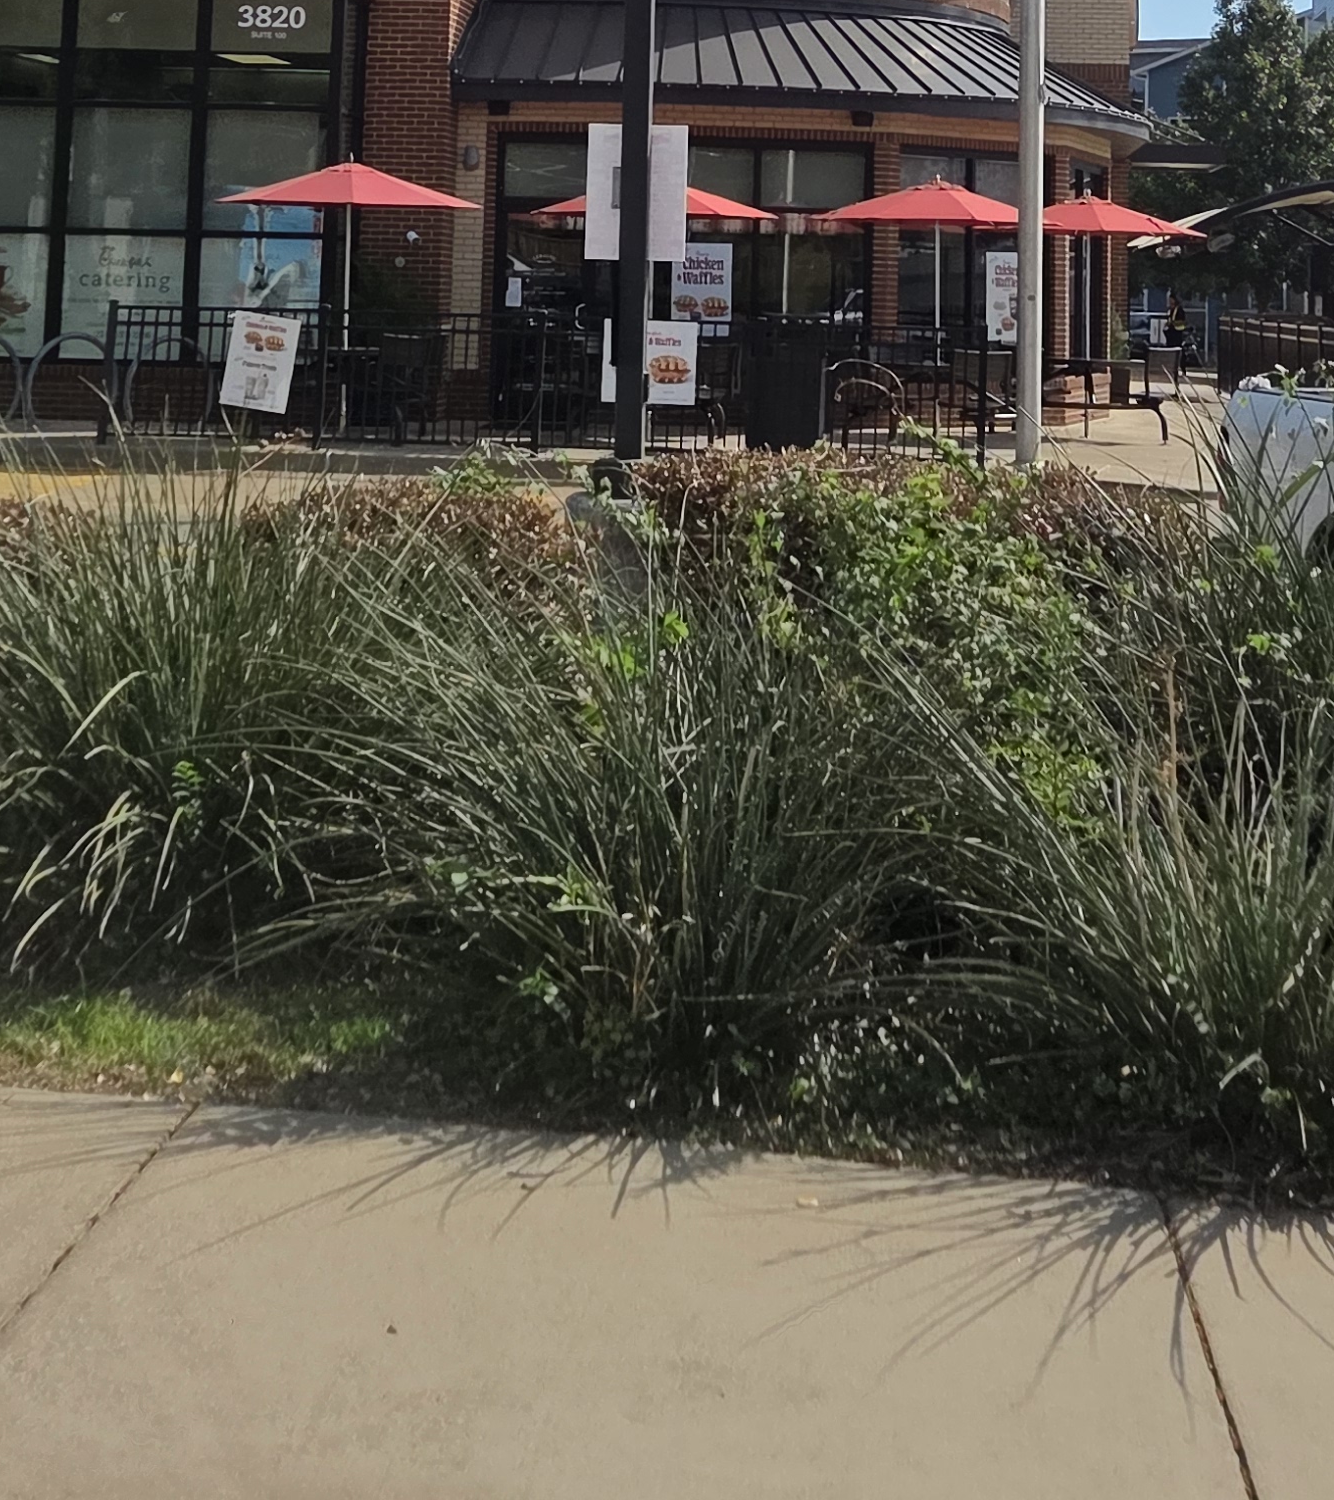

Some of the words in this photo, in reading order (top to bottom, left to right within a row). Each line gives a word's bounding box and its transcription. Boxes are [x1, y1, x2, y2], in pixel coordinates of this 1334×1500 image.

[237, 4, 306, 29] 3820
[683, 257, 724, 270] Chicken
[79, 273, 170, 293] catering
[683, 272, 724, 285] Waffles
